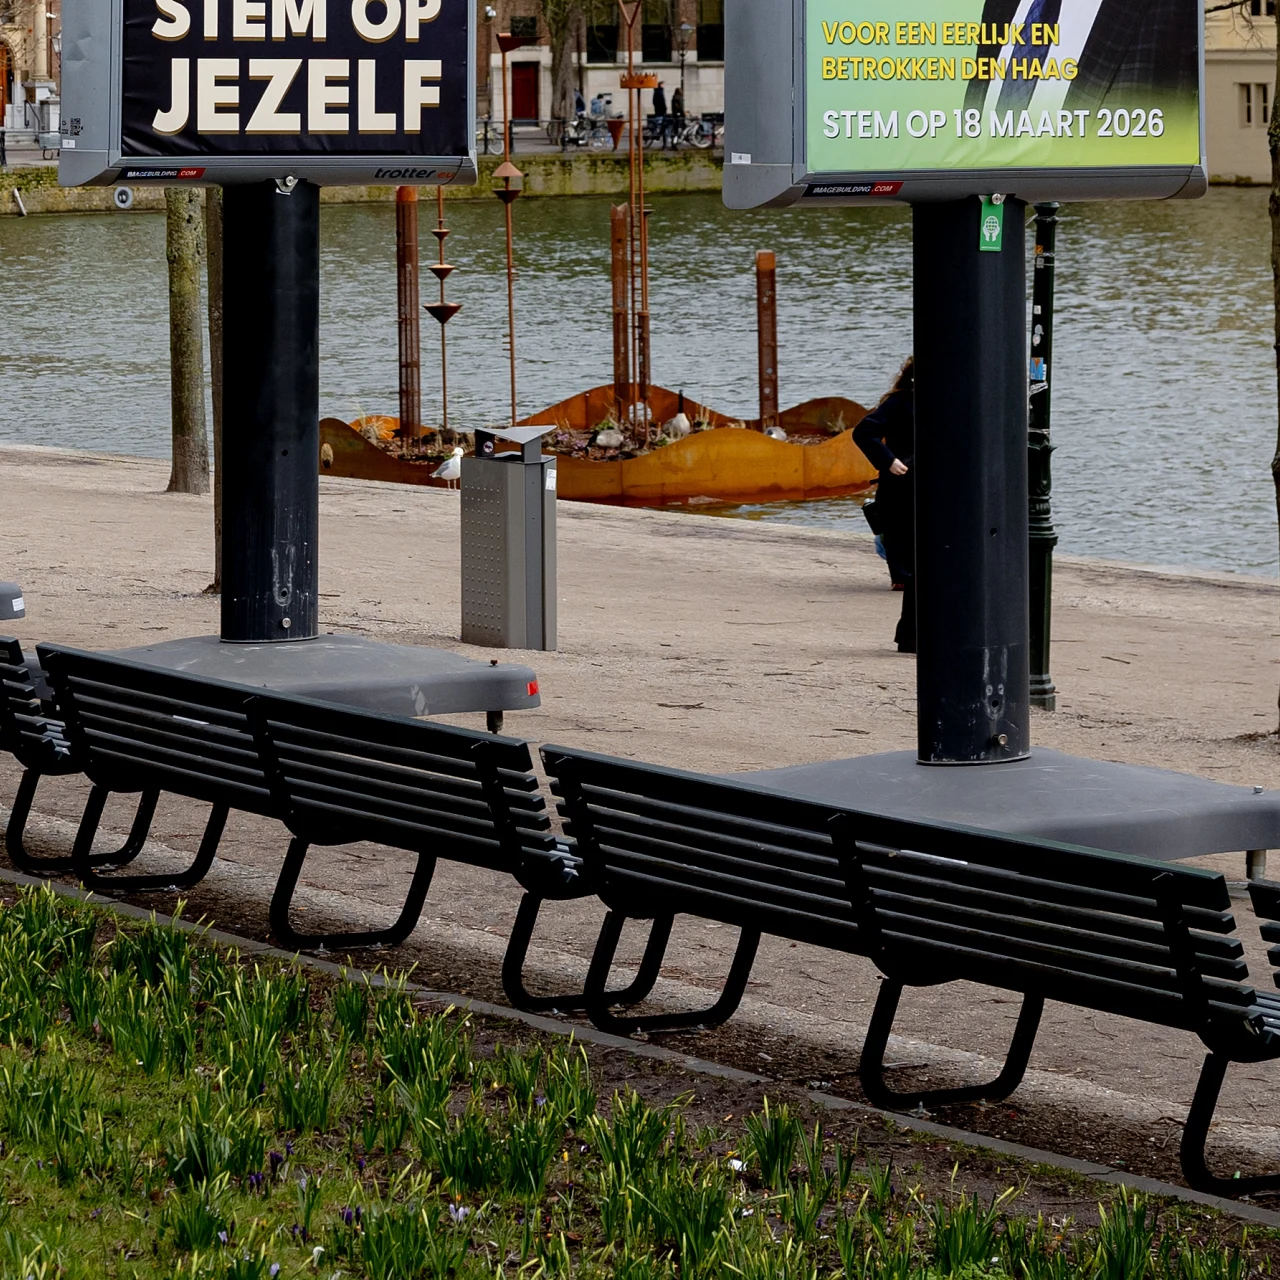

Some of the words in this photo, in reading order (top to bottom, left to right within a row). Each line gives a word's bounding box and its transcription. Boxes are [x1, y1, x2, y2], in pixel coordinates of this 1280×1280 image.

[821, 21, 889, 44] VOOR
[896, 22, 936, 44] EEN
[942, 22, 1026, 45] EERLIJK
[1031, 23, 1060, 45] EN
[822, 57, 955, 80] BETROKKEN
[961, 57, 1006, 80] DEN
[1012, 58, 1078, 81] HAAG
[152, 58, 442, 136] JEZELF
[823, 109, 898, 138] STEM
[905, 109, 947, 138] OP
[953, 109, 981, 138] 18
[989, 109, 1090, 138] MAART
[1097, 108, 1165, 137] 2026
[374, 167, 436, 179] trotter
